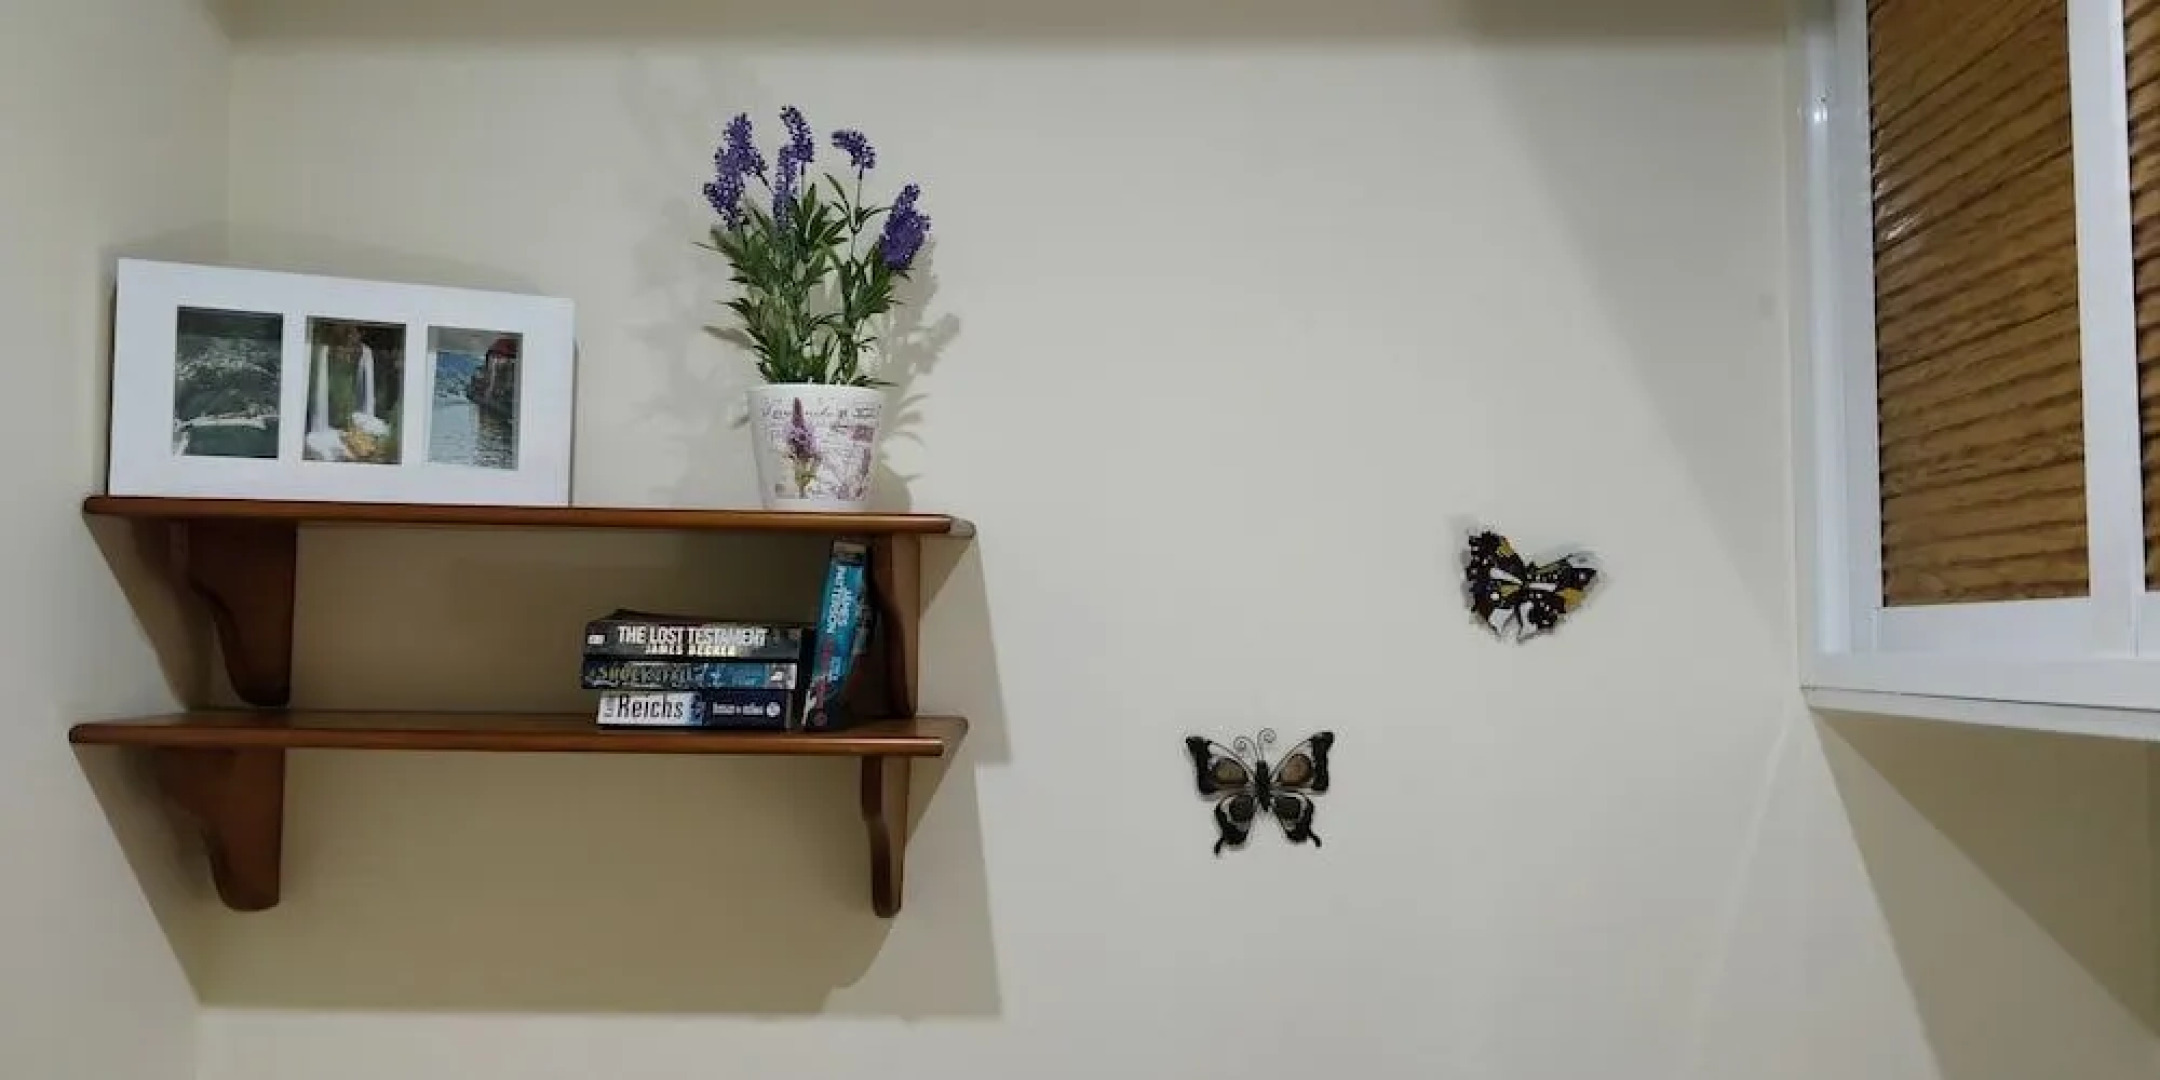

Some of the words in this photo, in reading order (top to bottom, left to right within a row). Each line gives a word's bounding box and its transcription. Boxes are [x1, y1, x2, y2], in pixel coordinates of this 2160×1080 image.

[617, 625, 647, 644] THE
[650, 626, 685, 645] LOST
[688, 627, 769, 647] TESTAMENT
[646, 644, 683, 656] JAMES
[617, 694, 684, 719] Reichs
